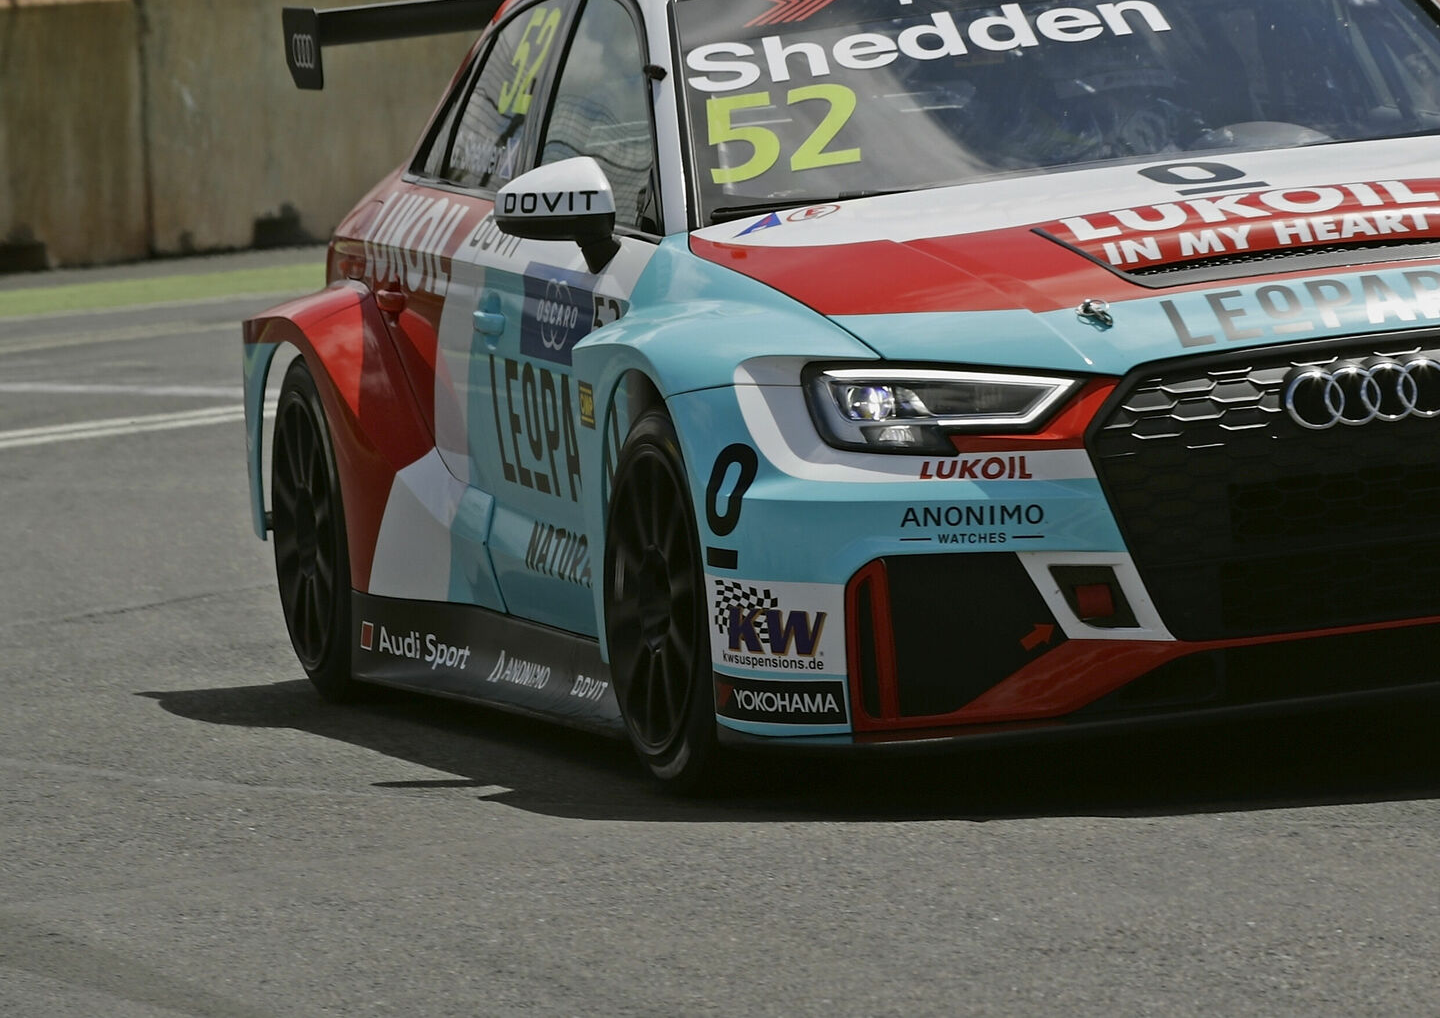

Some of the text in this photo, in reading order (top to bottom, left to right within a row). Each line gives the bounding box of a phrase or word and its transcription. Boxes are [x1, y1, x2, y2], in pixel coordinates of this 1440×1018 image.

[498, 8, 562, 115] 52
[687, 0, 1171, 92] Shedden
[705, 84, 863, 185] 52
[504, 190, 599, 214] DOVIT
[1058, 180, 1440, 242] LUKOIL
[365, 191, 469, 298] LUKOIL
[1101, 207, 1432, 267] IN MY HEART
[536, 299, 579, 330] OSCARO
[489, 353, 583, 503] LEOPA
[919, 455, 1033, 480] LUKOIL
[900, 504, 1045, 528] ANONIMO
[937, 532, 1007, 545] WATCHES
[525, 520, 593, 589] NATURA
[379, 625, 471, 670] Audi Sport
[727, 605, 828, 658] KW
[501, 656, 551, 690] ANONIMO
[722, 649, 825, 671] kwsuspensions.de
[570, 674, 609, 701] DOVIT
[733, 688, 840, 714] YOKOHAMA
